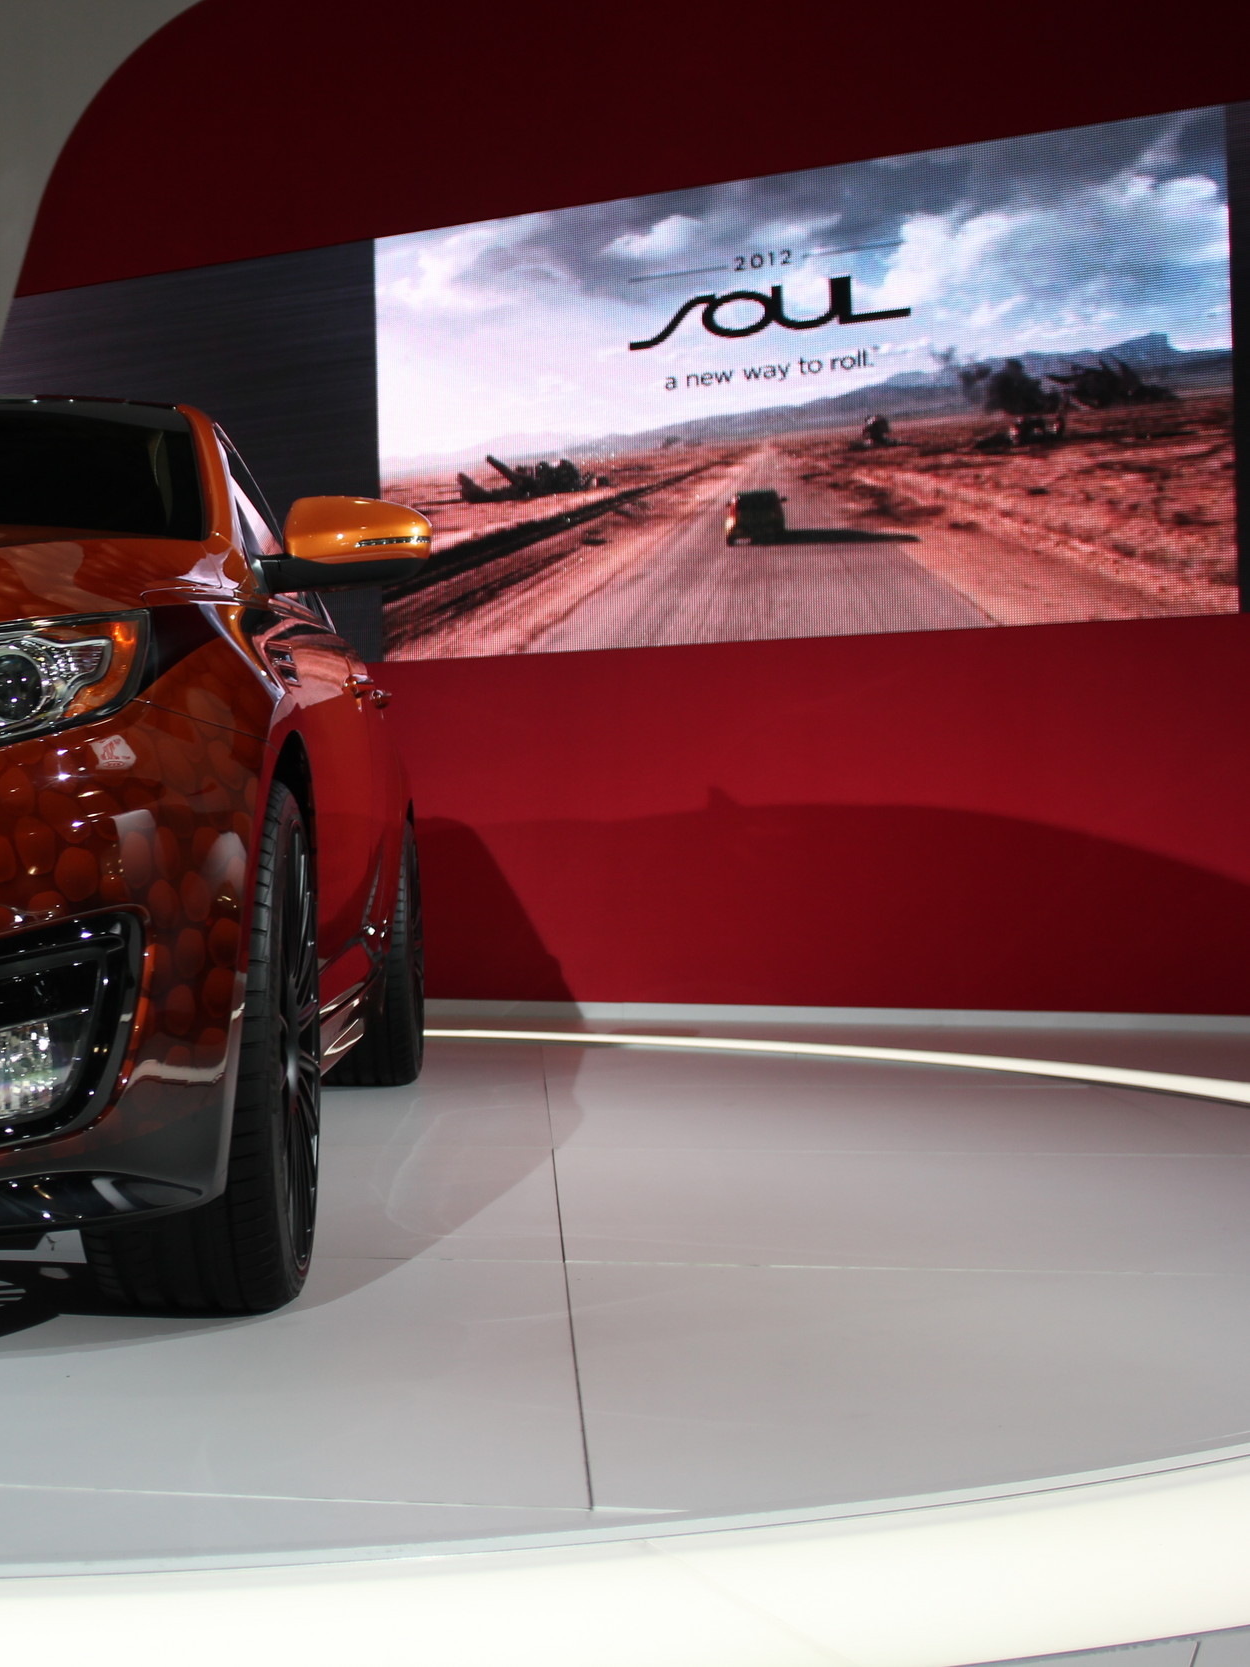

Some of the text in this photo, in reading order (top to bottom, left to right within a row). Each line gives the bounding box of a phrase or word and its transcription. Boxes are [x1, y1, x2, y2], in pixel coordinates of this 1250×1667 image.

[734, 249, 792, 272] 2012
[629, 275, 911, 351] SOUL
[664, 375, 677, 391] a
[686, 368, 733, 387] new
[743, 361, 790, 382] way
[799, 355, 823, 375] to
